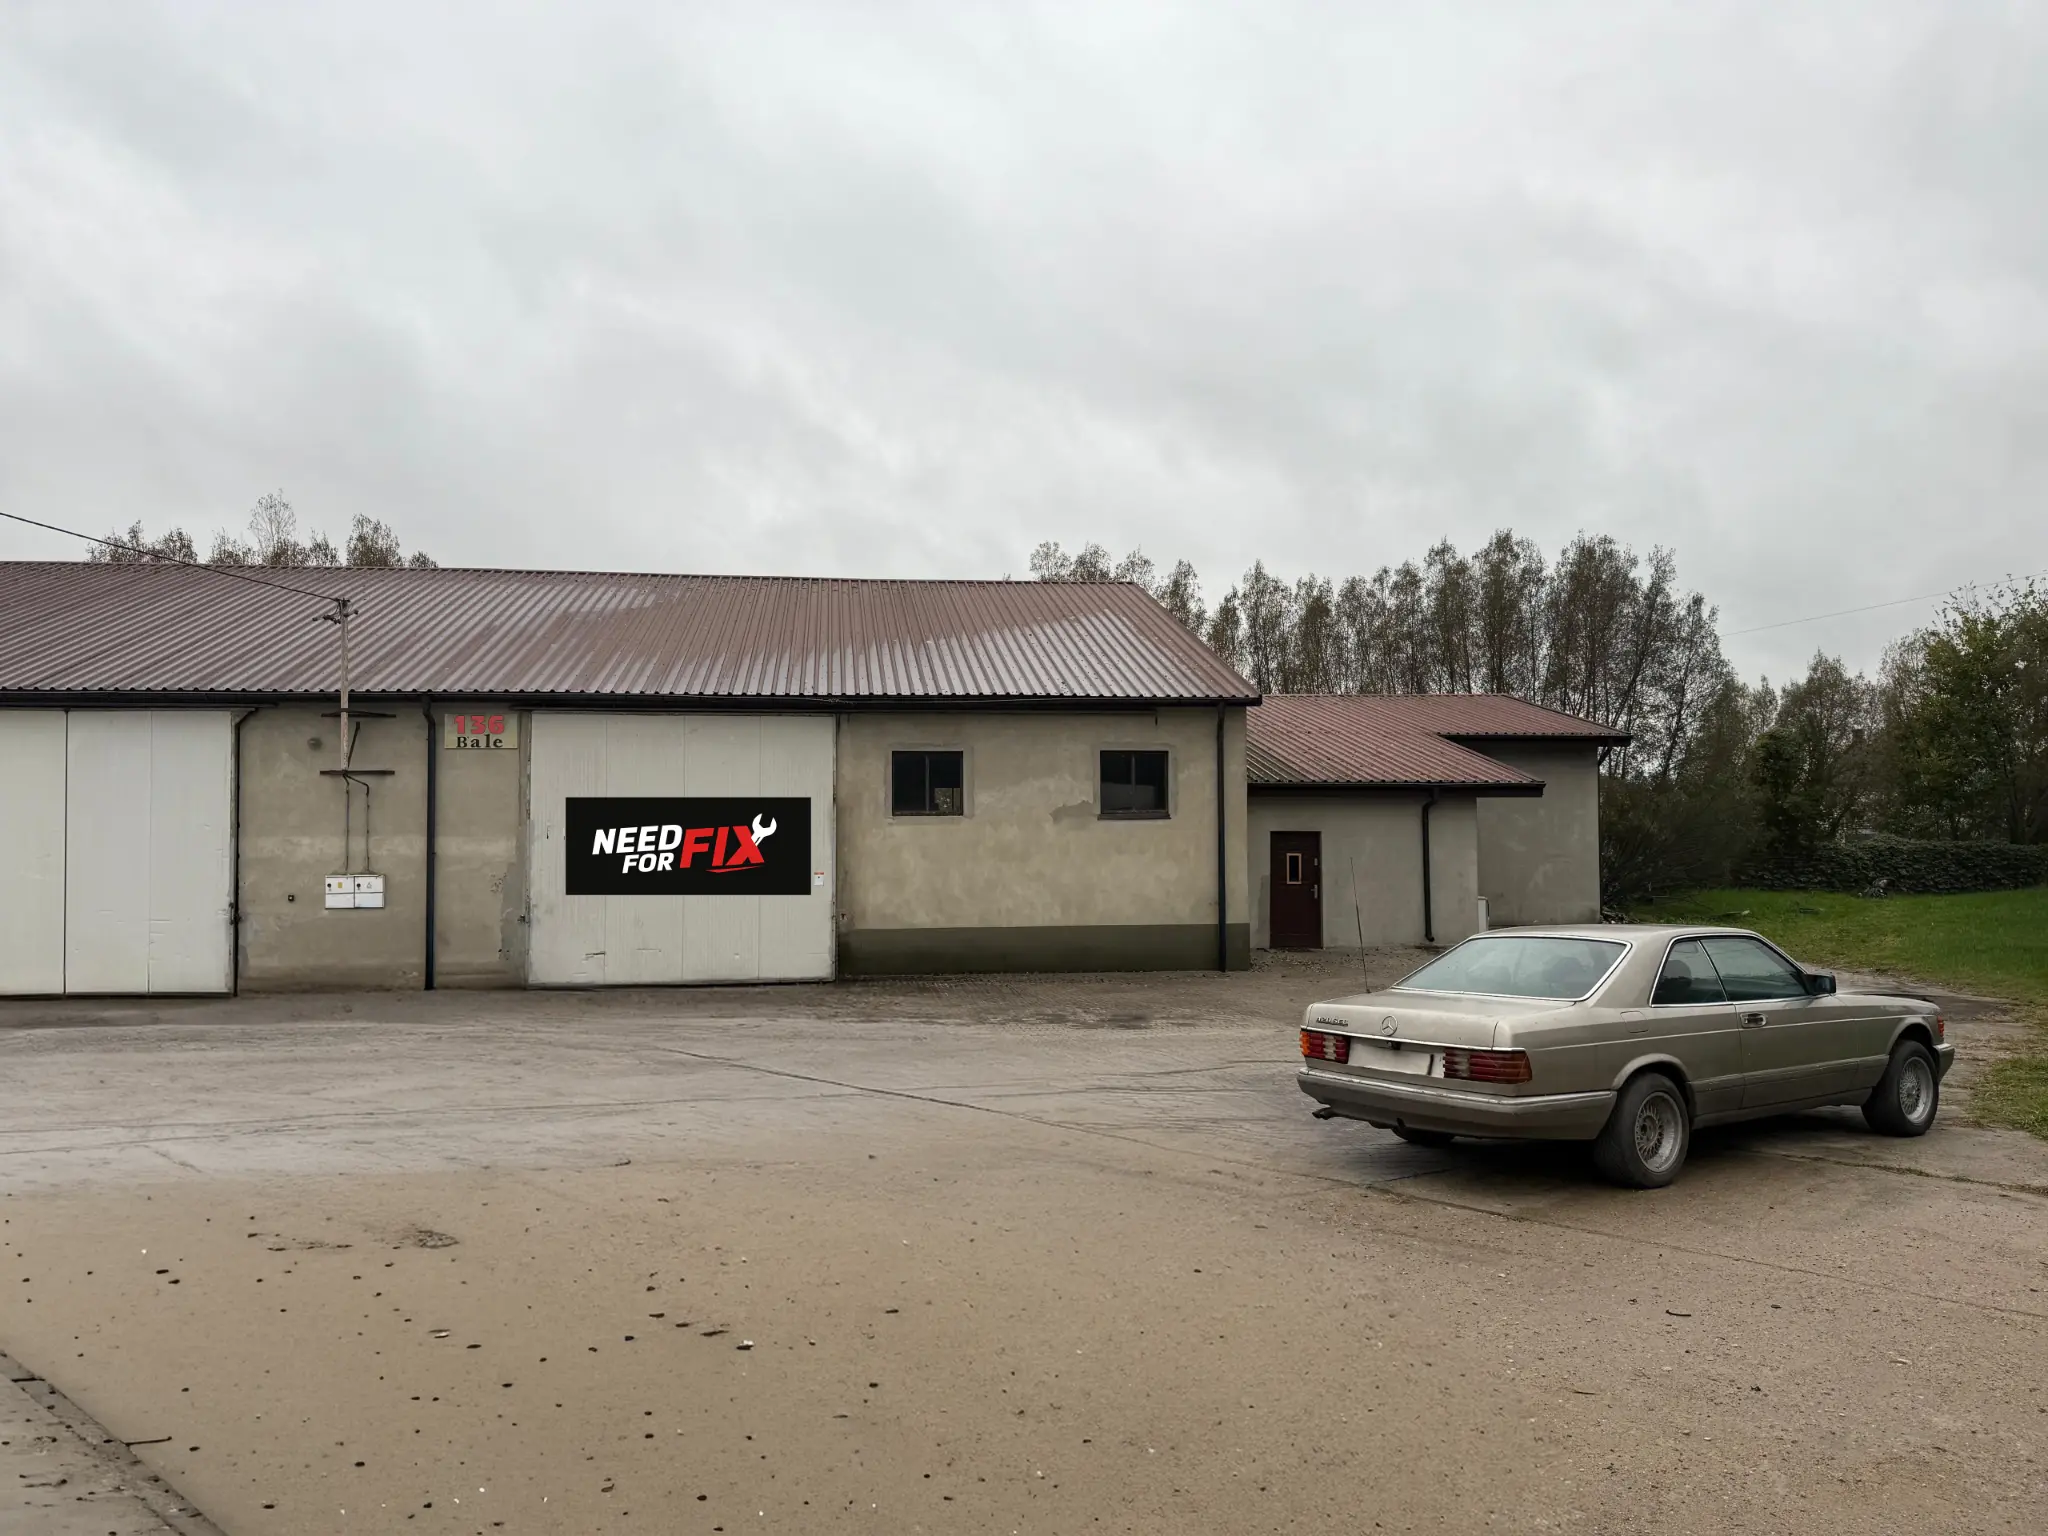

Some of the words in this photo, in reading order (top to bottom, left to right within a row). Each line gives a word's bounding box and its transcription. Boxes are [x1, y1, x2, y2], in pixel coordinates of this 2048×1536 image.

[454, 714, 505, 735] 136
[456, 734, 504, 748] Bale
[592, 824, 683, 855] NEED
[679, 825, 766, 869] FIX
[622, 852, 675, 874] FOR
